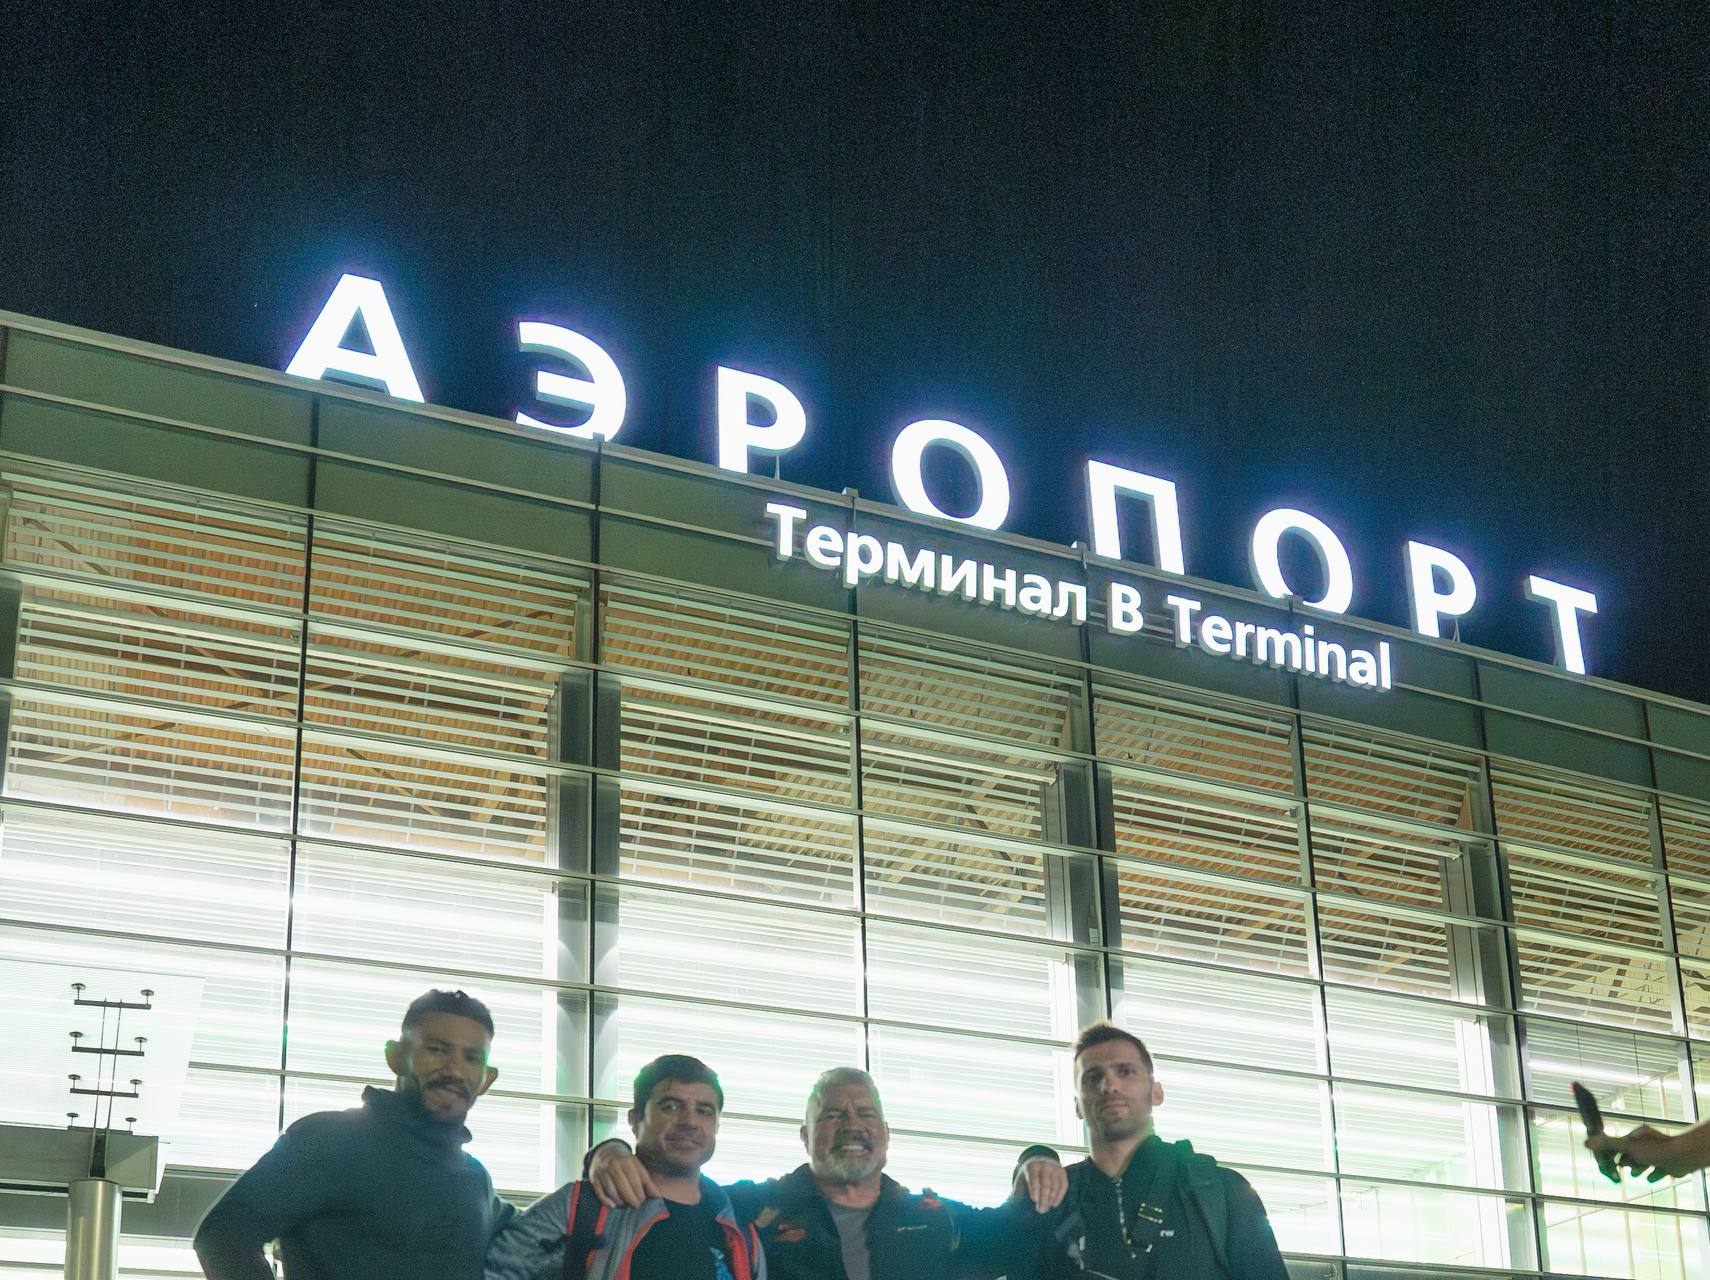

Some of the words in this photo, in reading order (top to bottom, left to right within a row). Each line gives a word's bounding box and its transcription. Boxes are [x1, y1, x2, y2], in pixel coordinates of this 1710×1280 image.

[285, 273, 1598, 676] АЭРОПОРТ
[765, 502, 1088, 623] Терминал
[1166, 594, 1393, 691] Terminal
